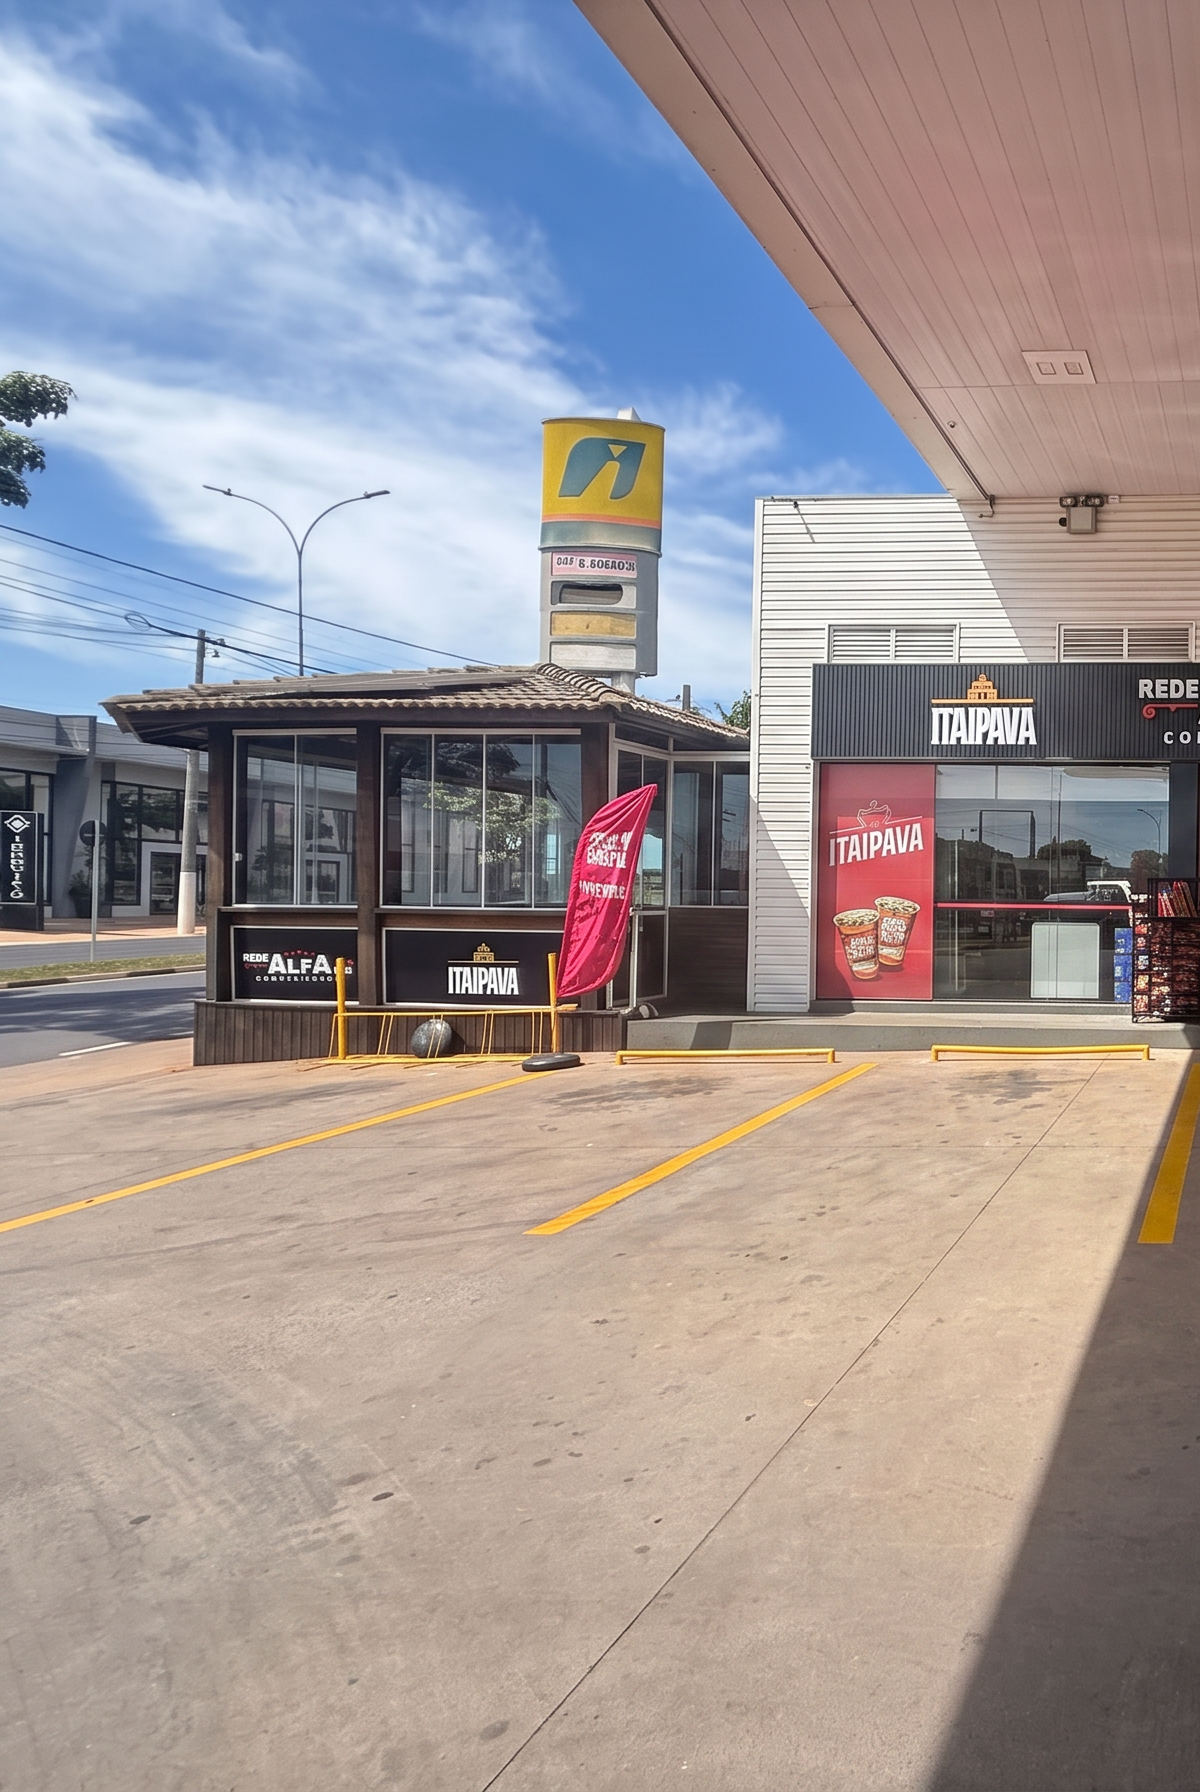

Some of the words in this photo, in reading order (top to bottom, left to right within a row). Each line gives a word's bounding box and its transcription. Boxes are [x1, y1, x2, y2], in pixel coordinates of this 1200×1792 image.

[1138, 679, 1199, 699] REDE
[930, 706, 1038, 745] ITAIPAVA
[828, 822, 924, 867] ITAIPAVA
[242, 953, 269, 963] REDE
[267, 953, 333, 975] ALFA
[447, 966, 519, 995] ITAIPAVA
